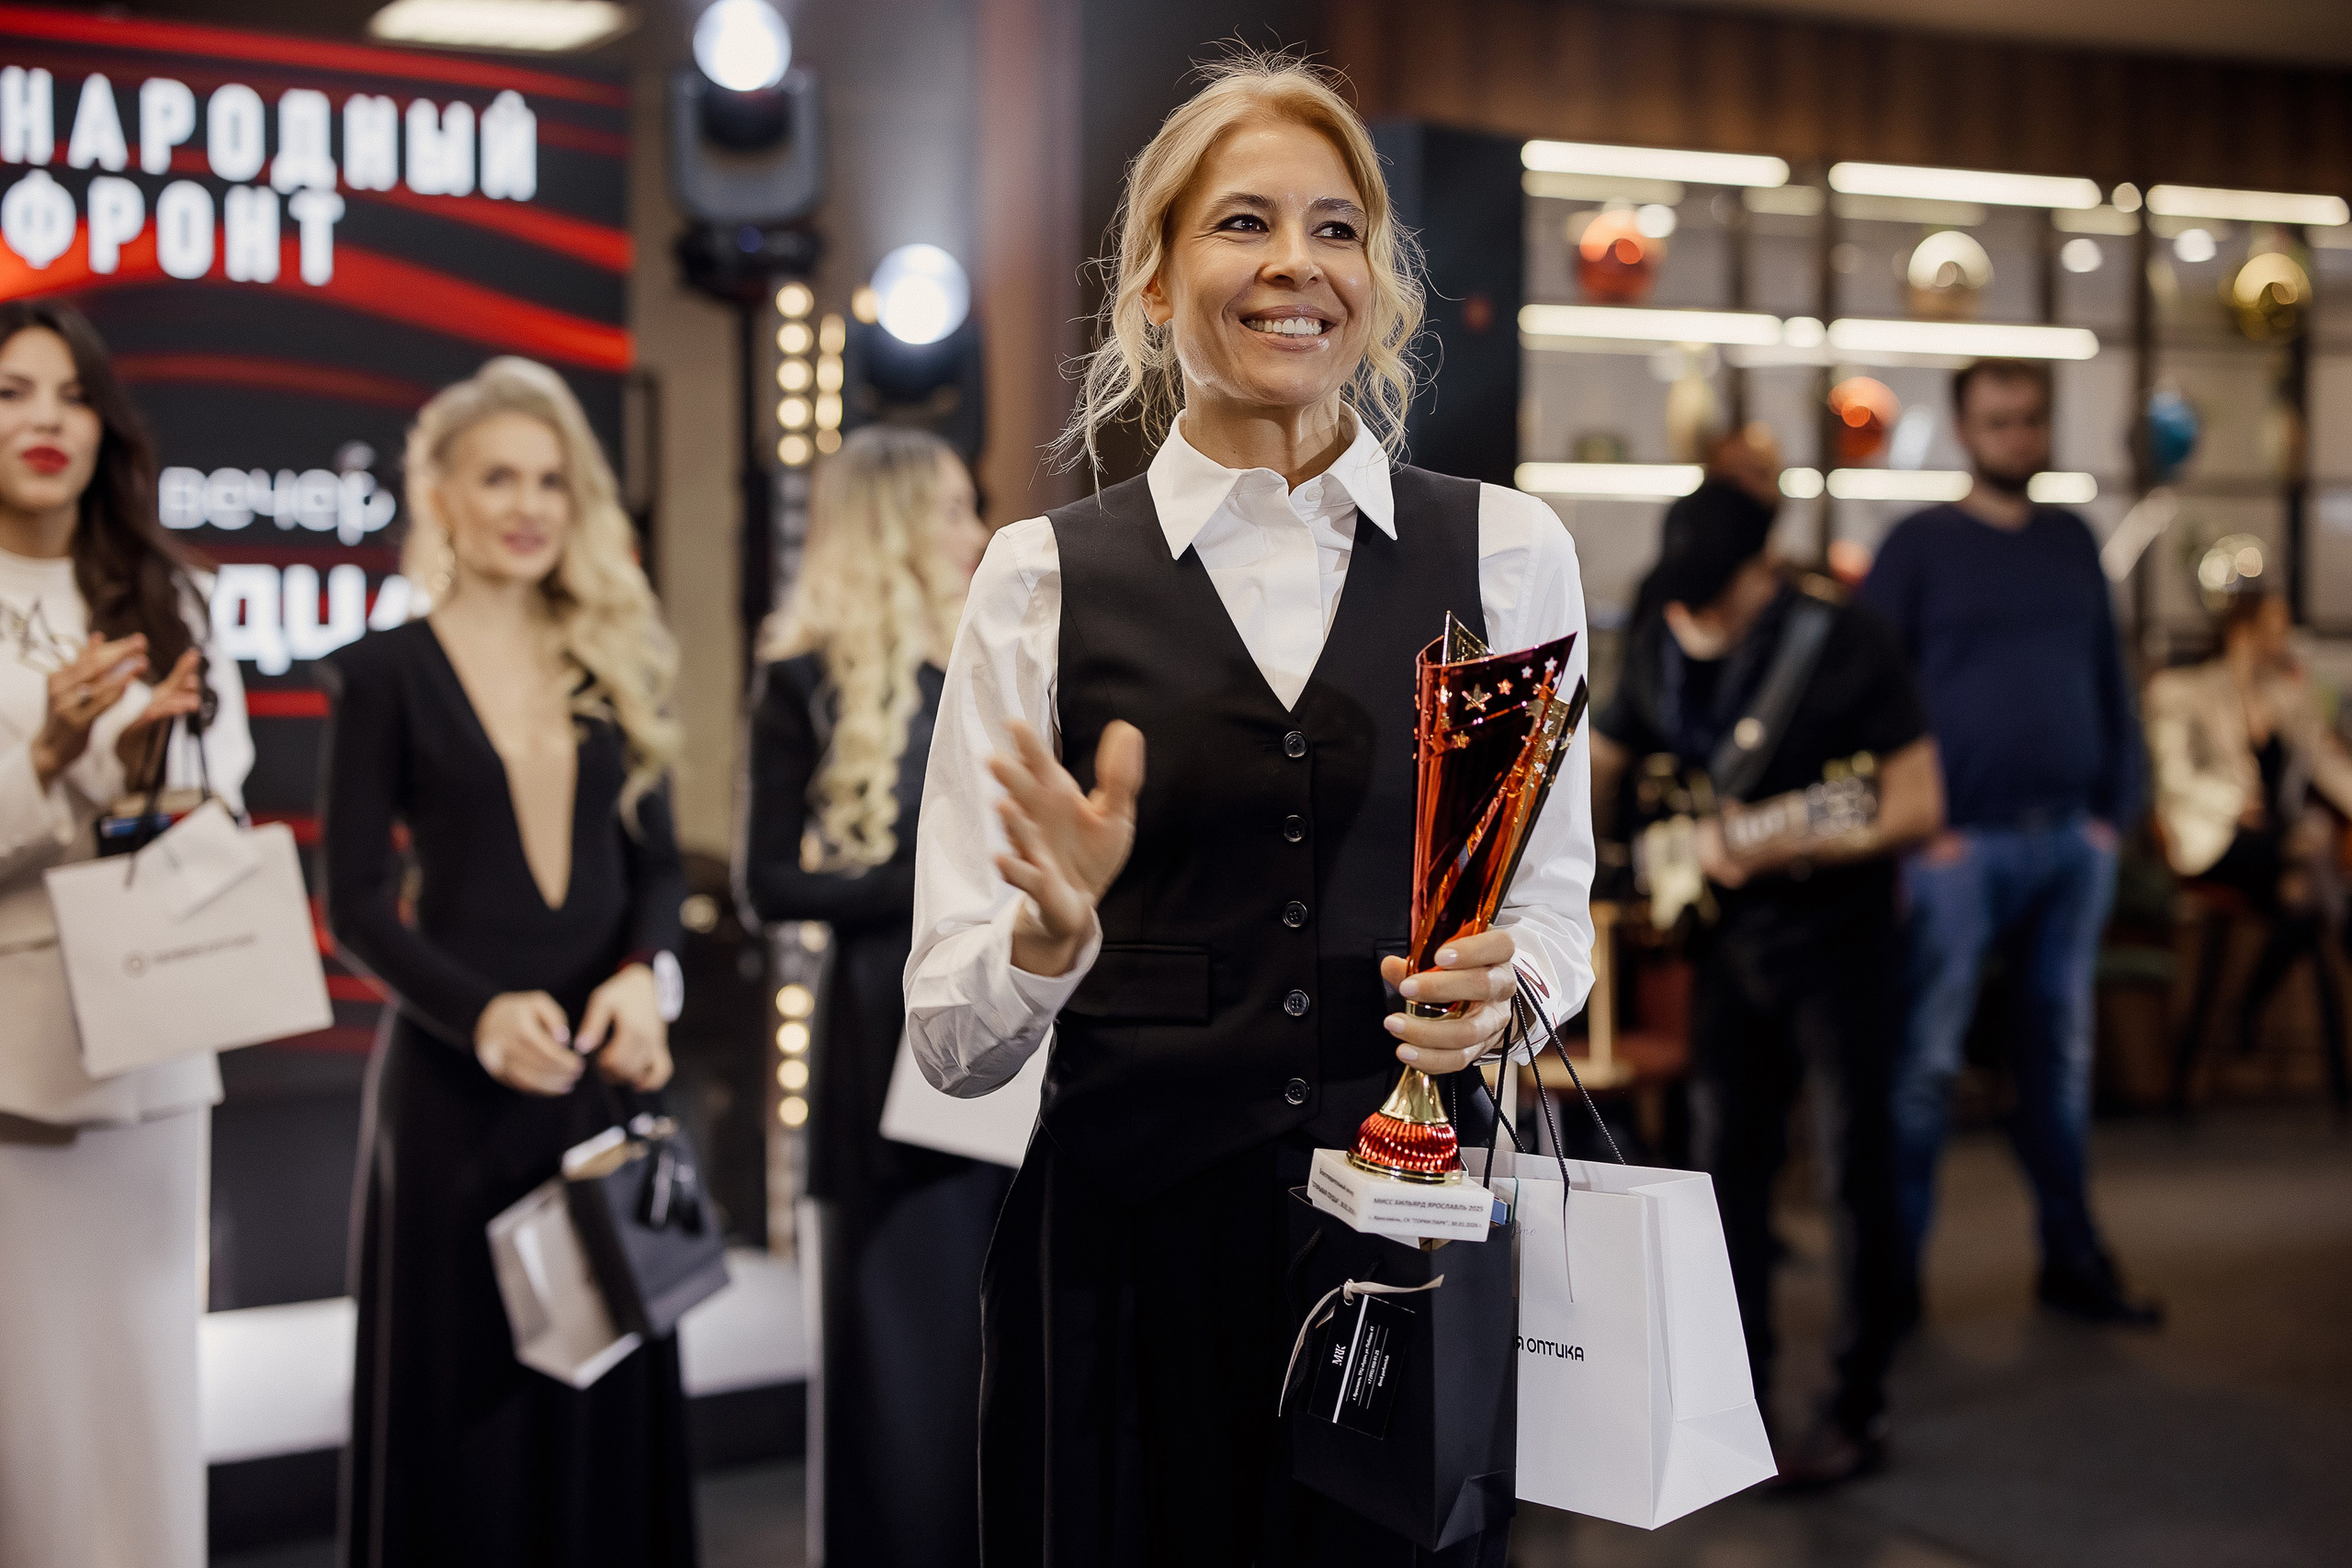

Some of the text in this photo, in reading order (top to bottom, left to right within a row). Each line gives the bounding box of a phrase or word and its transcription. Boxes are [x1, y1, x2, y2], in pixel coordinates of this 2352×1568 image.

[0, 65, 538, 201] НАРОДНЫЙ
[0, 170, 345, 286] ФРОНТ
[1427, 1201, 1466, 1211] ЯРОСЛАВЛЬ
[1527, 1337, 1585, 1362] ОПТИКА
